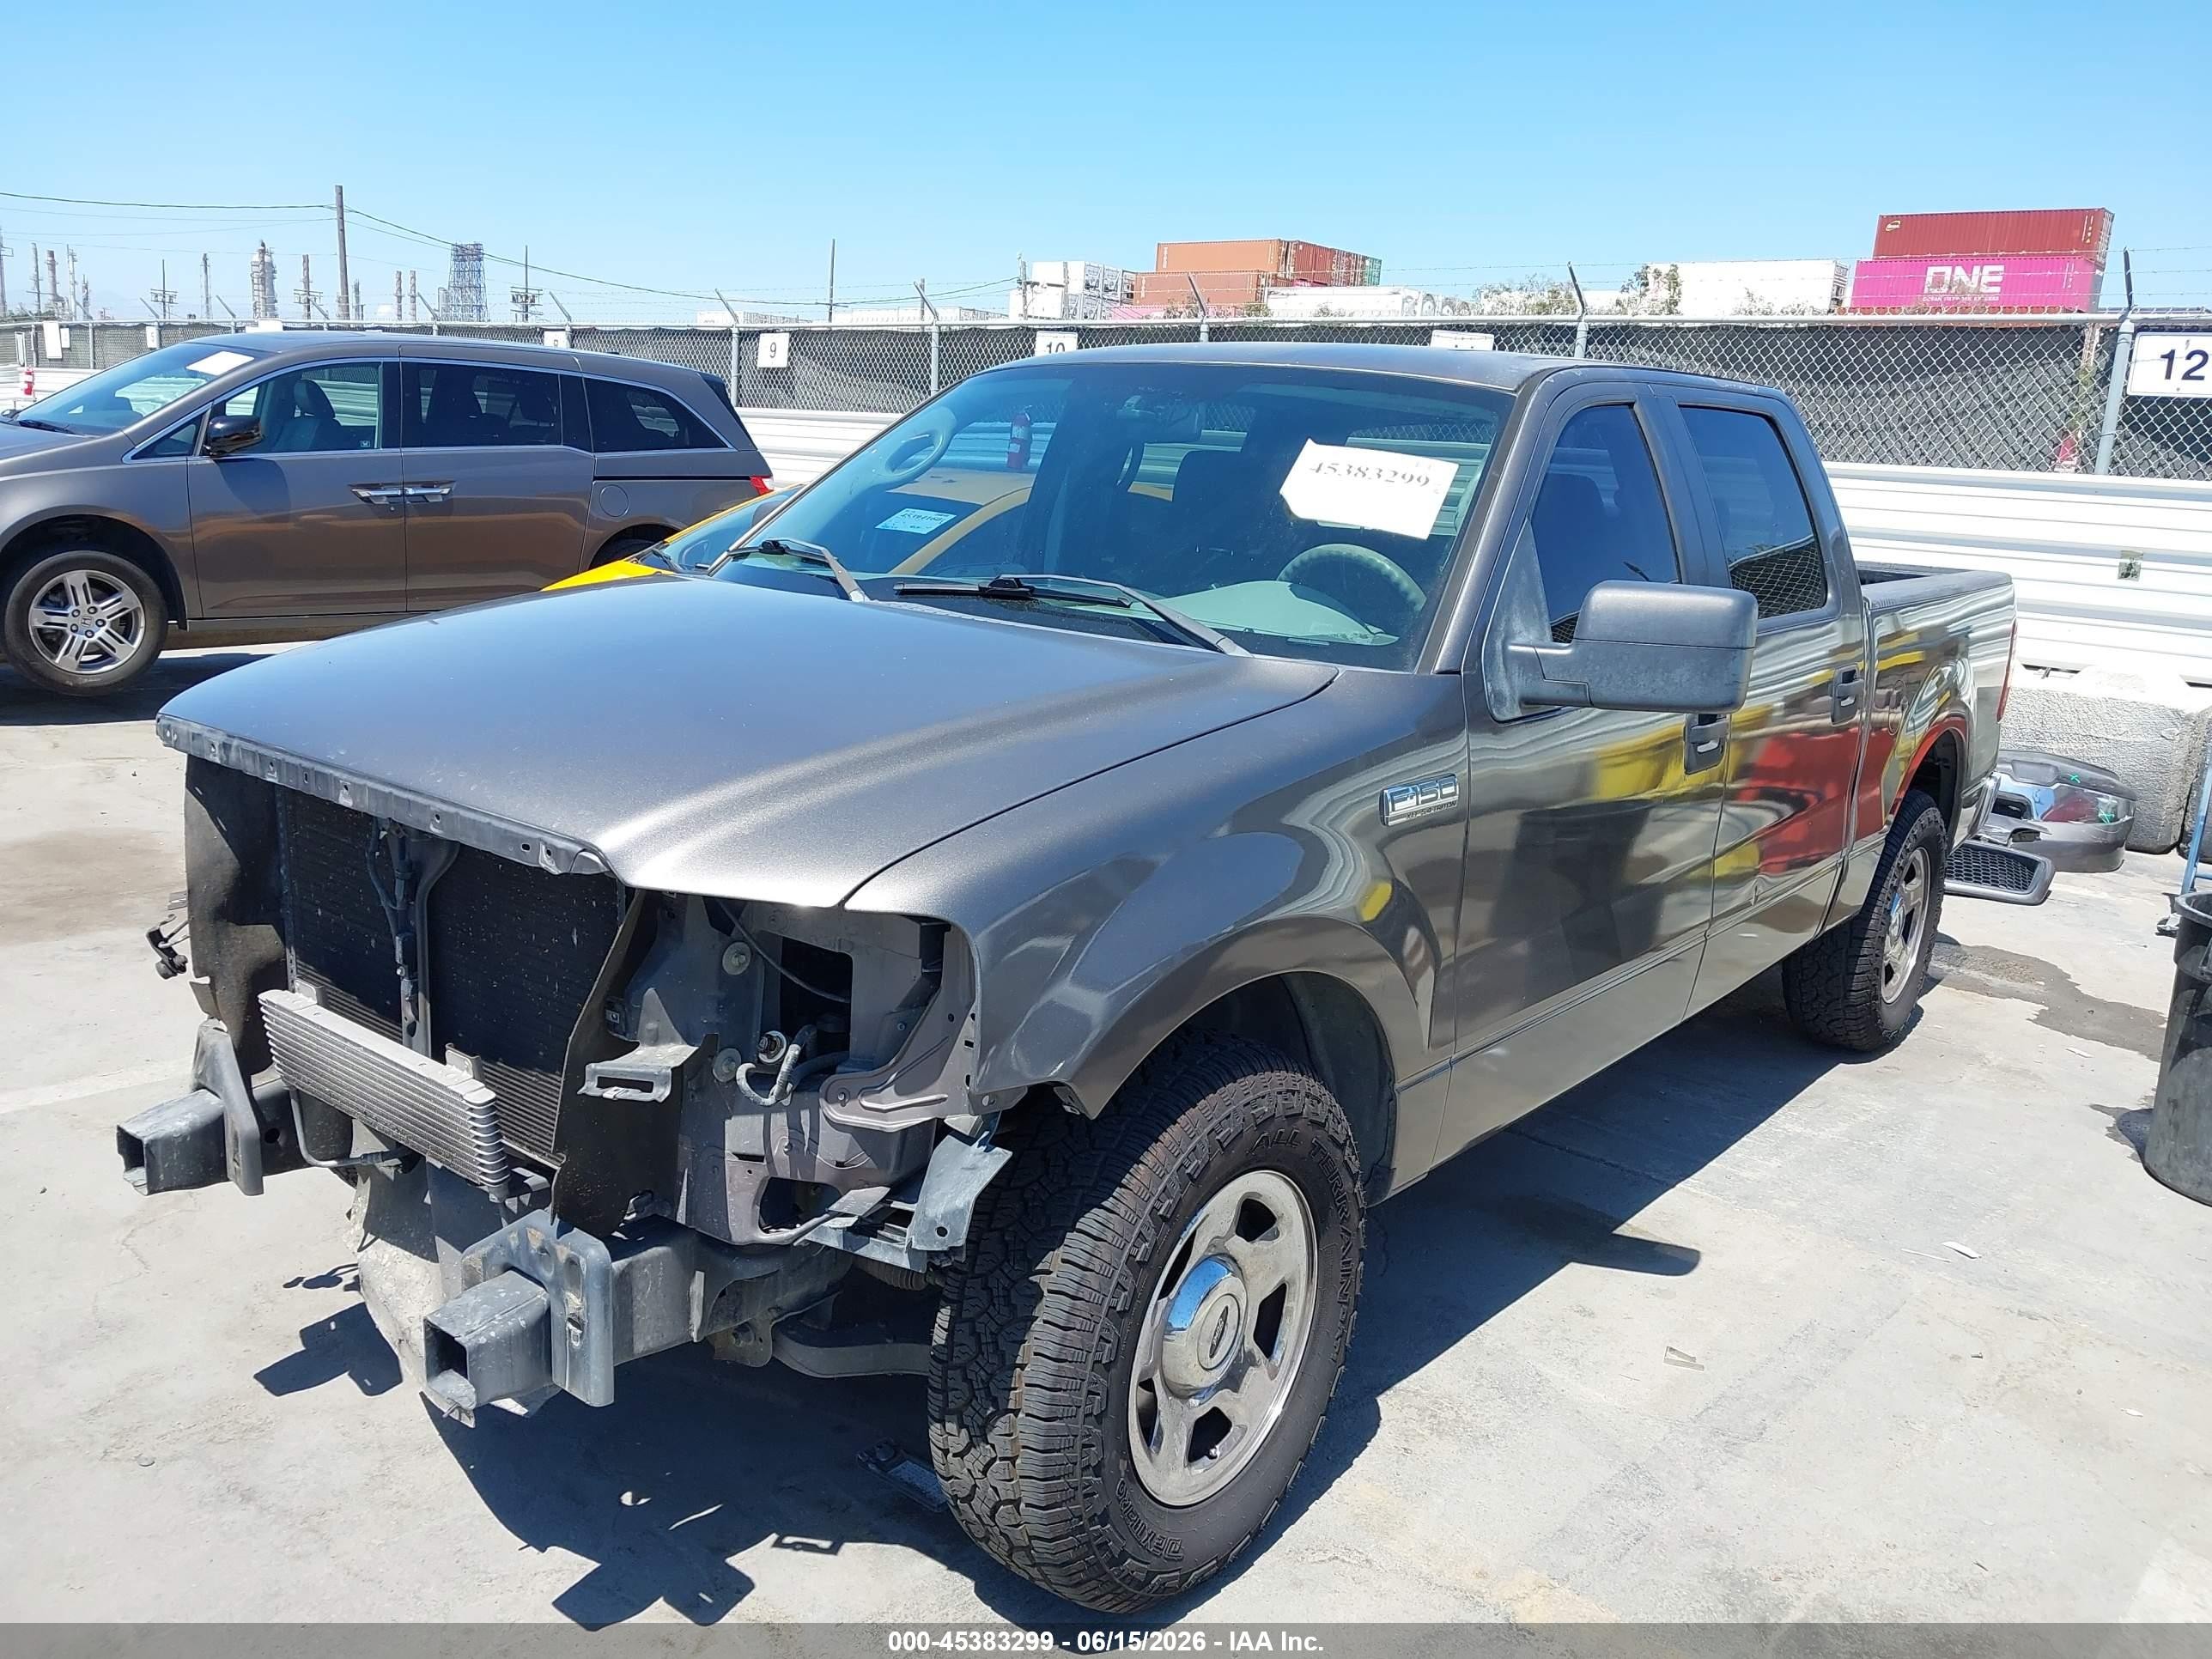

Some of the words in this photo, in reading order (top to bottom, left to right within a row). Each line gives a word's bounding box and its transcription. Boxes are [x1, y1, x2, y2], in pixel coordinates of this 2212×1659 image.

[1923, 264, 2005, 293] ONE
[769, 342, 777, 358] 9
[2160, 349, 2209, 380] 12
[1310, 461, 1431, 488] 45383299
[1246, 1127, 1304, 1155] ALL
[1310, 1136, 1354, 1304] TERRAIN
